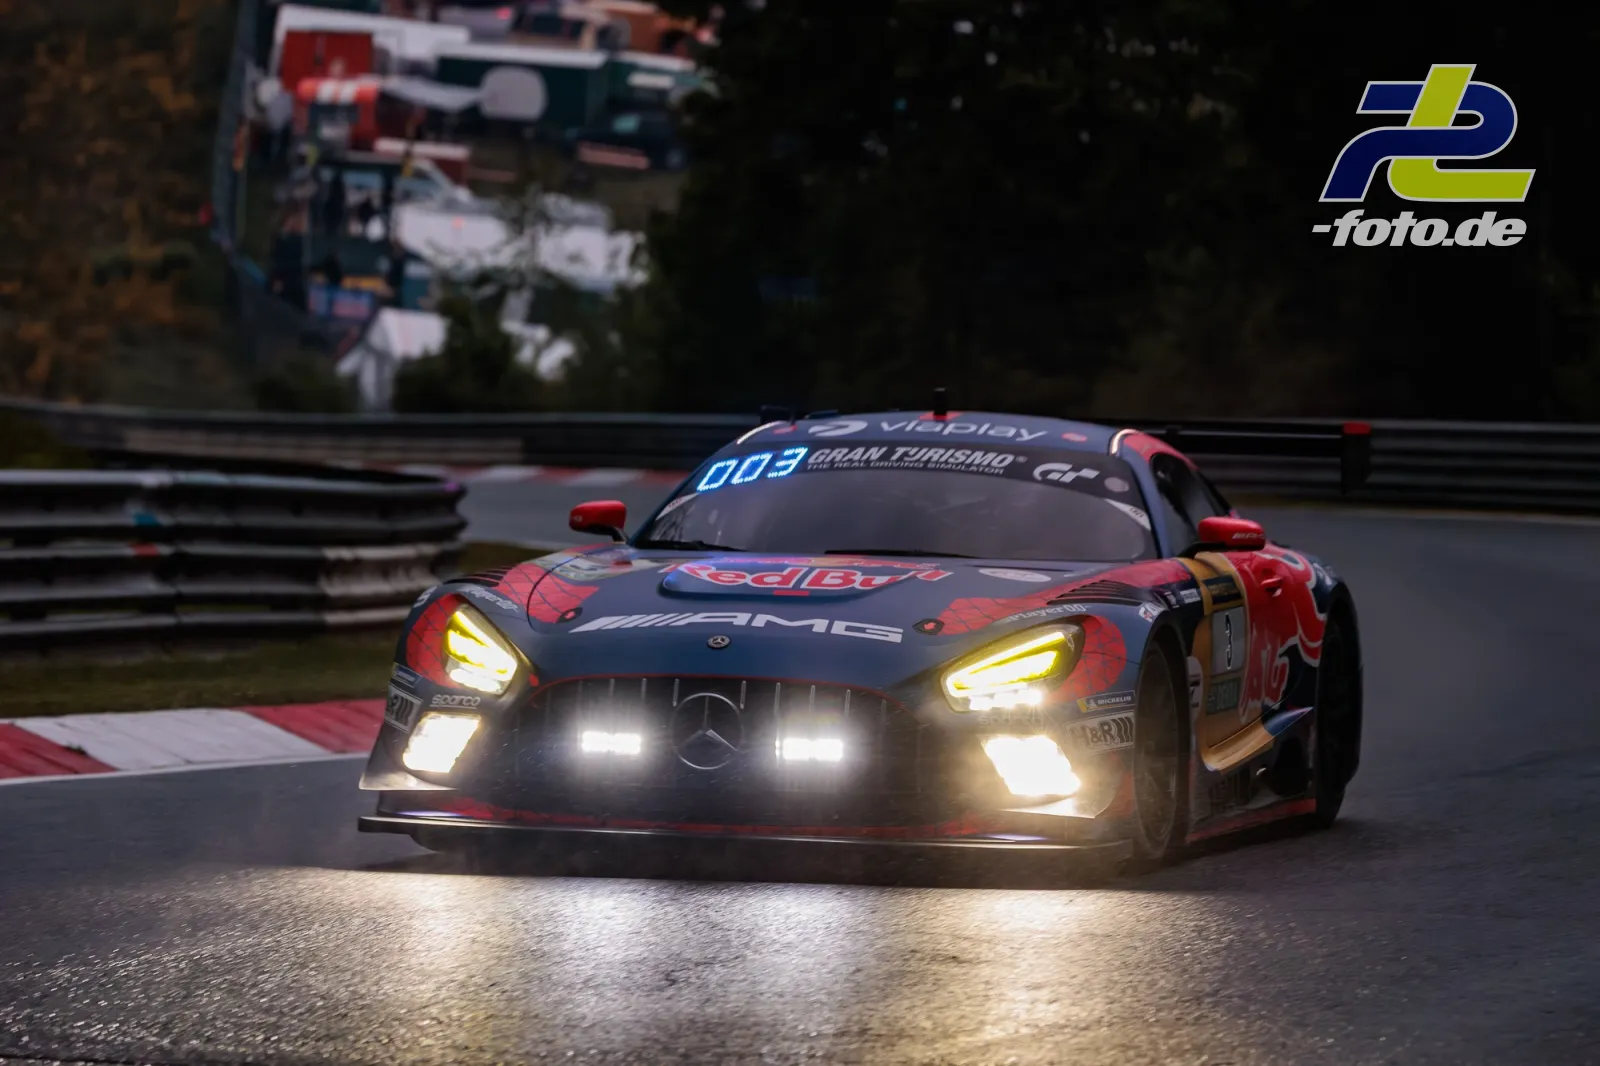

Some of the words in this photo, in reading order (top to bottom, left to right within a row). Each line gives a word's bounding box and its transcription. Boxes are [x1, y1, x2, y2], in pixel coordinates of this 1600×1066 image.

[880, 420, 1049, 442] viaplay
[807, 446, 888, 465] GRAN
[697, 447, 809, 491] 003
[806, 463, 830, 471] THE
[832, 461, 868, 469] REAL
[869, 460, 924, 469] DRIVING
[927, 462, 1005, 475] SIMULATOR
[657, 563, 809, 588] Red
[431, 693, 481, 706] sparco
[1097, 695, 1132, 706] MICHELIN
